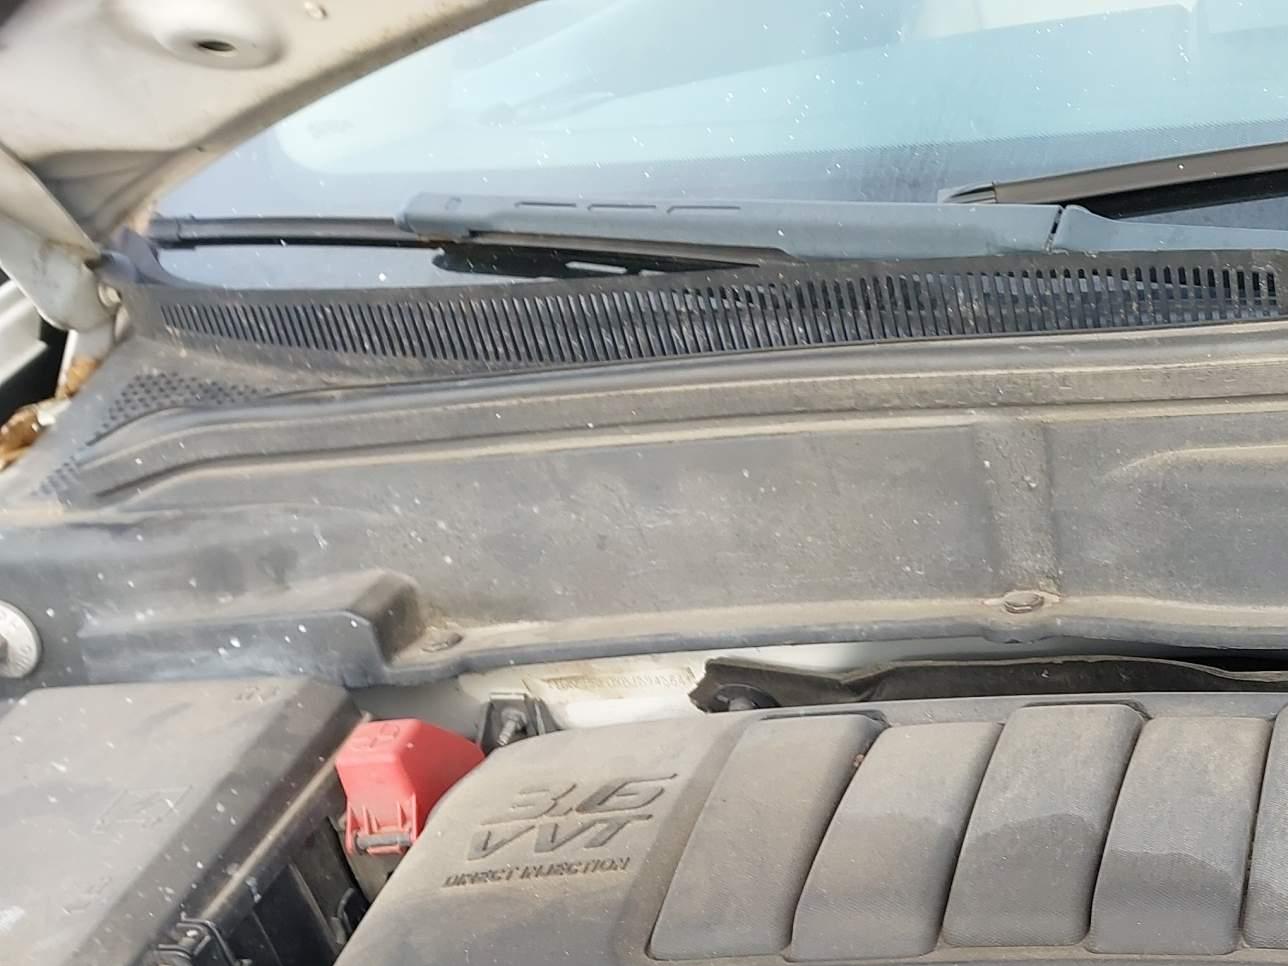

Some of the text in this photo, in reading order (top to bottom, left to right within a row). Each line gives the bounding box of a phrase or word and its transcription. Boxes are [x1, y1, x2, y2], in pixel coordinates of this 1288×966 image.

[479, 773, 678, 826] 3.6
[466, 814, 653, 861] VVT
[442, 856, 631, 888] DIRECT INJECTION
